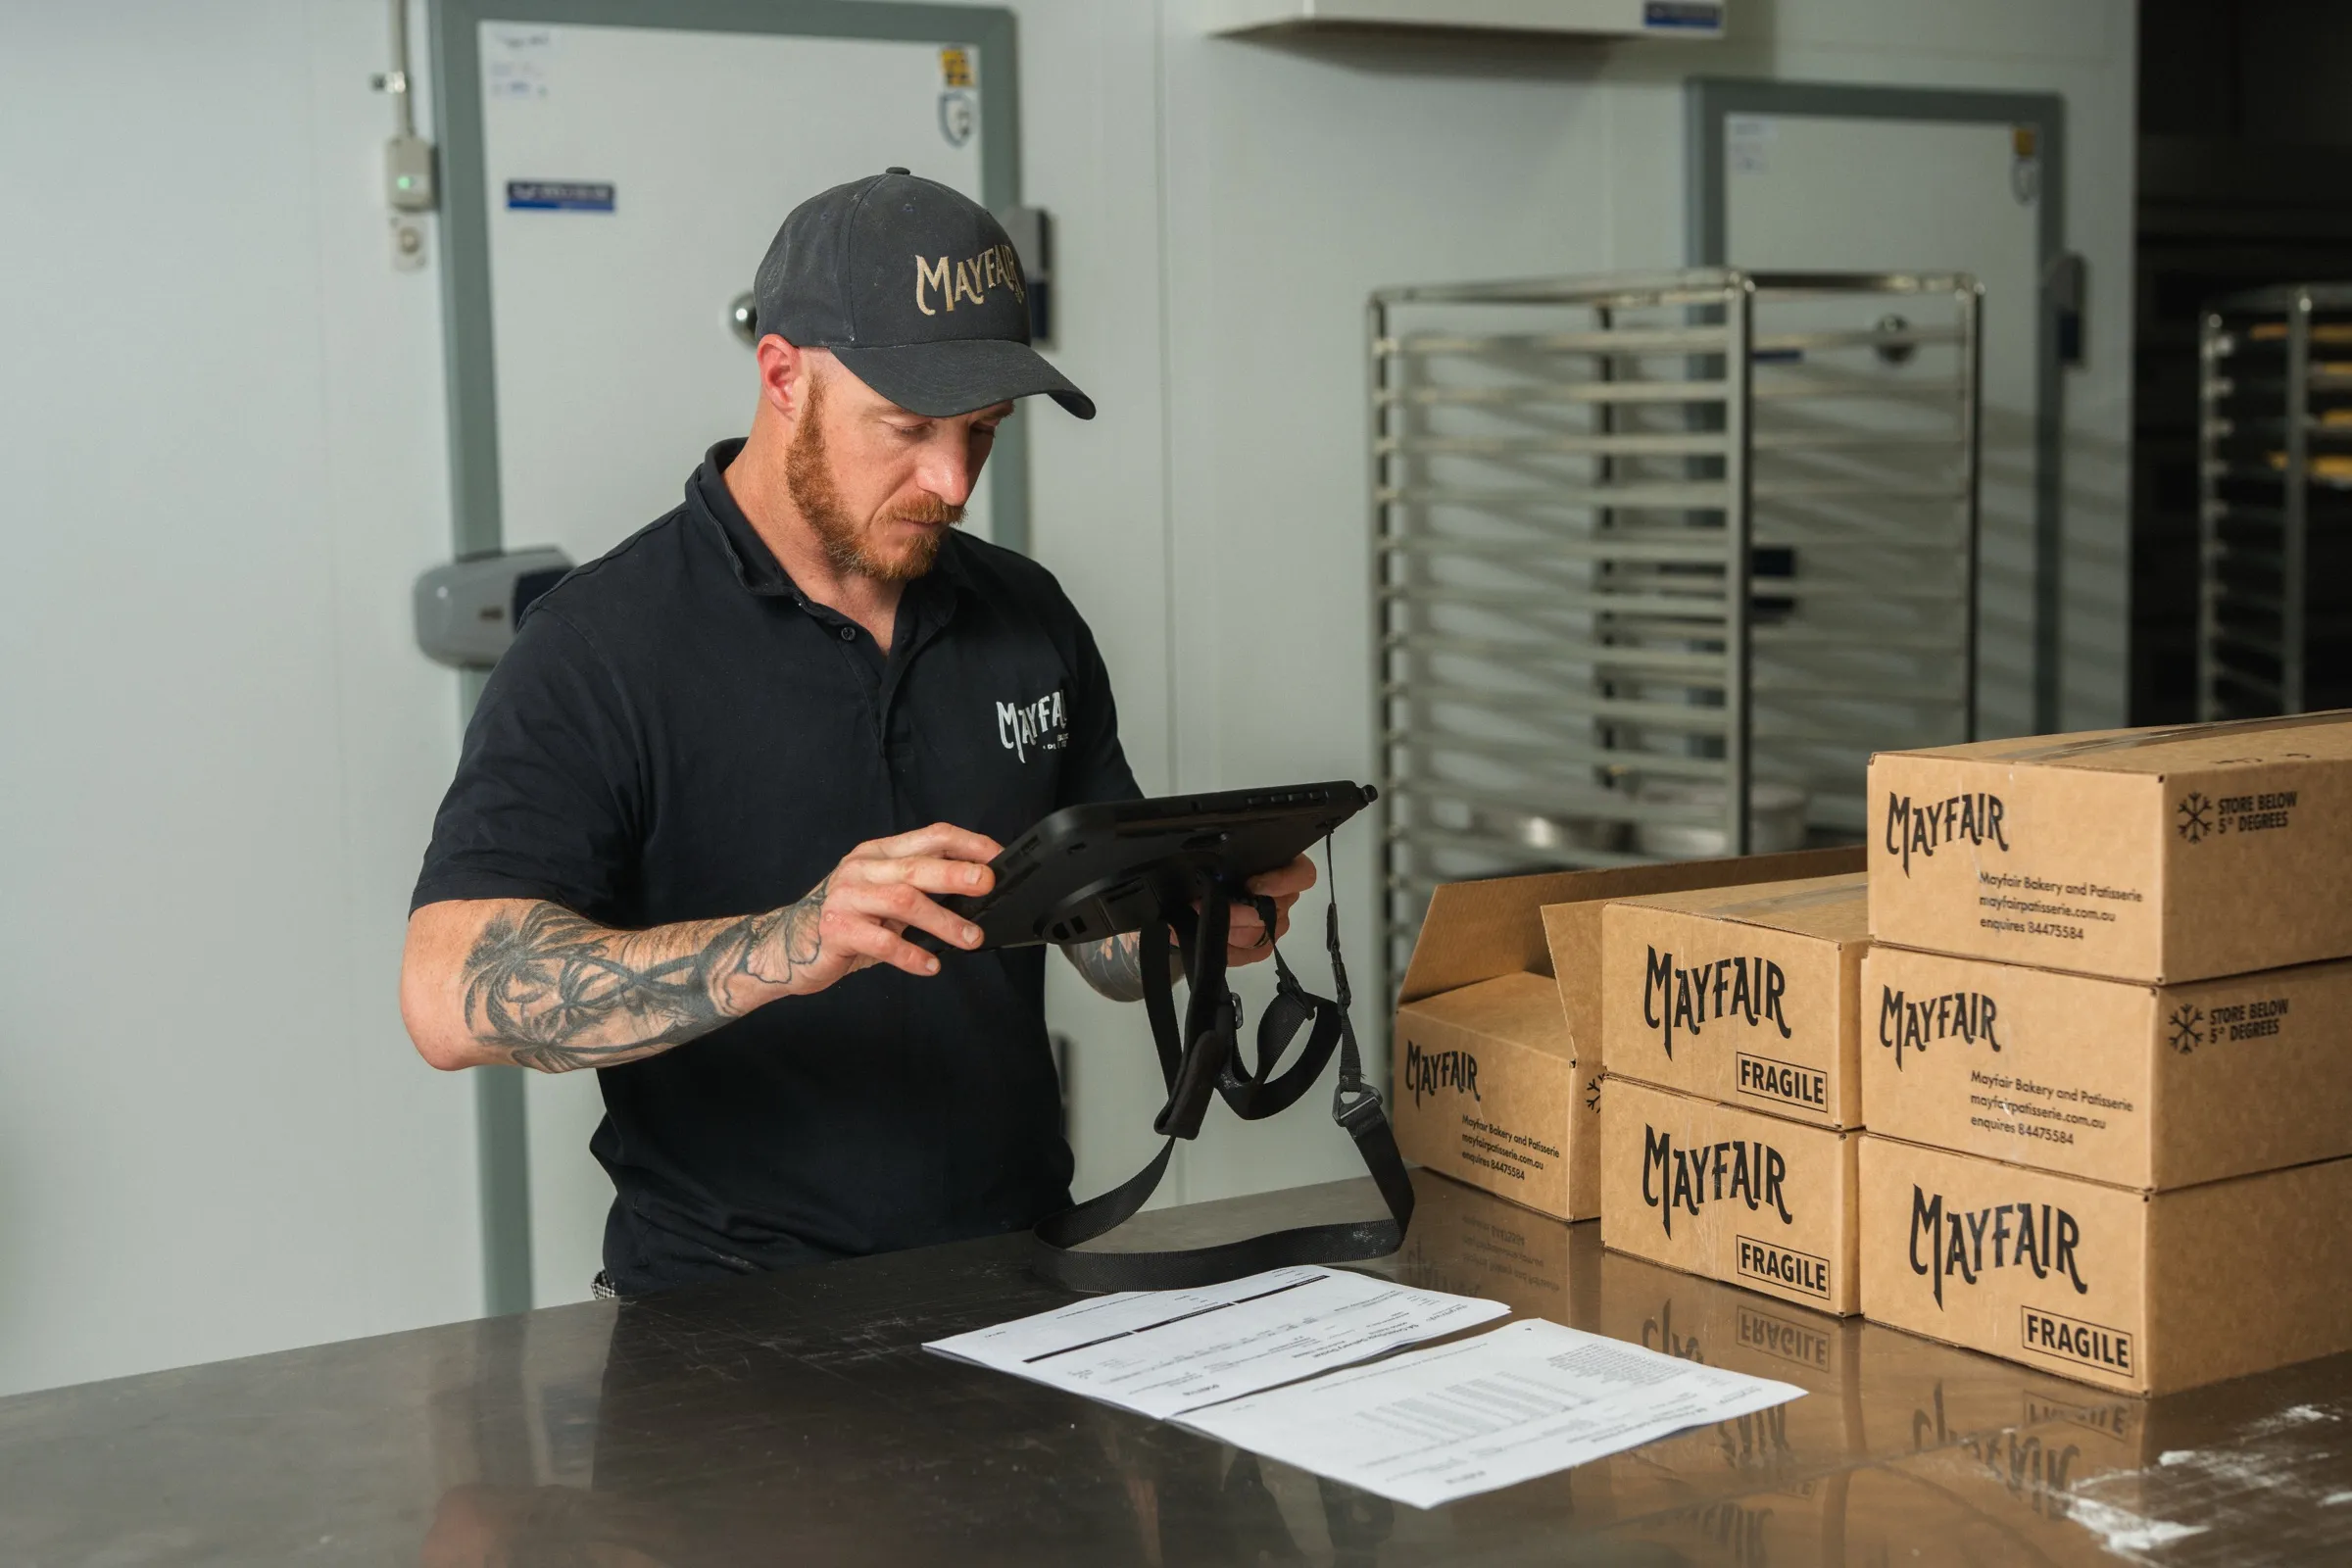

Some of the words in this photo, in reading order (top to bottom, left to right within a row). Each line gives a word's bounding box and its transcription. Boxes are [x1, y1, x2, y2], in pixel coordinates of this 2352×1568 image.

[2217, 796, 2254, 815] STORE
[2257, 791, 2298, 810] BELOW
[2237, 811, 2289, 832] DEGREES
[1886, 790, 2010, 879] MAYFAIR
[1979, 871, 2023, 891] Mayfair
[2024, 877, 2063, 896] Bakery
[2065, 881, 2087, 896] and
[2088, 883, 2144, 903] Patisserie
[1979, 894, 2117, 923] mayfairpatisserie.com.au
[1979, 915, 2026, 936] enquires
[1643, 943, 1792, 1061] MAYFAIR
[2208, 1006, 2246, 1026] STORE
[2249, 999, 2289, 1019] BELOW
[1879, 984, 2002, 1072] MAYFAIR
[2230, 1018, 2280, 1041] DEGREES
[1405, 1039, 1481, 1110] MAYFAIR
[1740, 1058, 1825, 1105] FRAGILE
[1970, 1070, 2013, 1091] Mayfair
[2015, 1078, 2054, 1100] Bakery
[2056, 1086, 2079, 1102] and
[2080, 1090, 2134, 1112] Patisserie
[1970, 1092, 2107, 1130] mayfairpatisserie.com.au
[1970, 1114, 2016, 1137] enquires
[2018, 1122, 2075, 1146] 84475584
[1461, 1114, 1489, 1132] Mayfair
[1489, 1124, 1513, 1143] Bakery
[1513, 1133, 1528, 1146] and
[1528, 1137, 1560, 1158] Patisserie
[1461, 1133, 1544, 1171] mayfairpatisserie.com.au
[1461, 1150, 1491, 1169] enquires
[1491, 1158, 1526, 1181] 84475584
[1642, 1123, 1793, 1241] MAYFAIR
[1740, 1242, 1828, 1293] FRAGILE
[1909, 1183, 2088, 1312] MAYFAIR
[2026, 1313, 2130, 1370] FRAGILE
